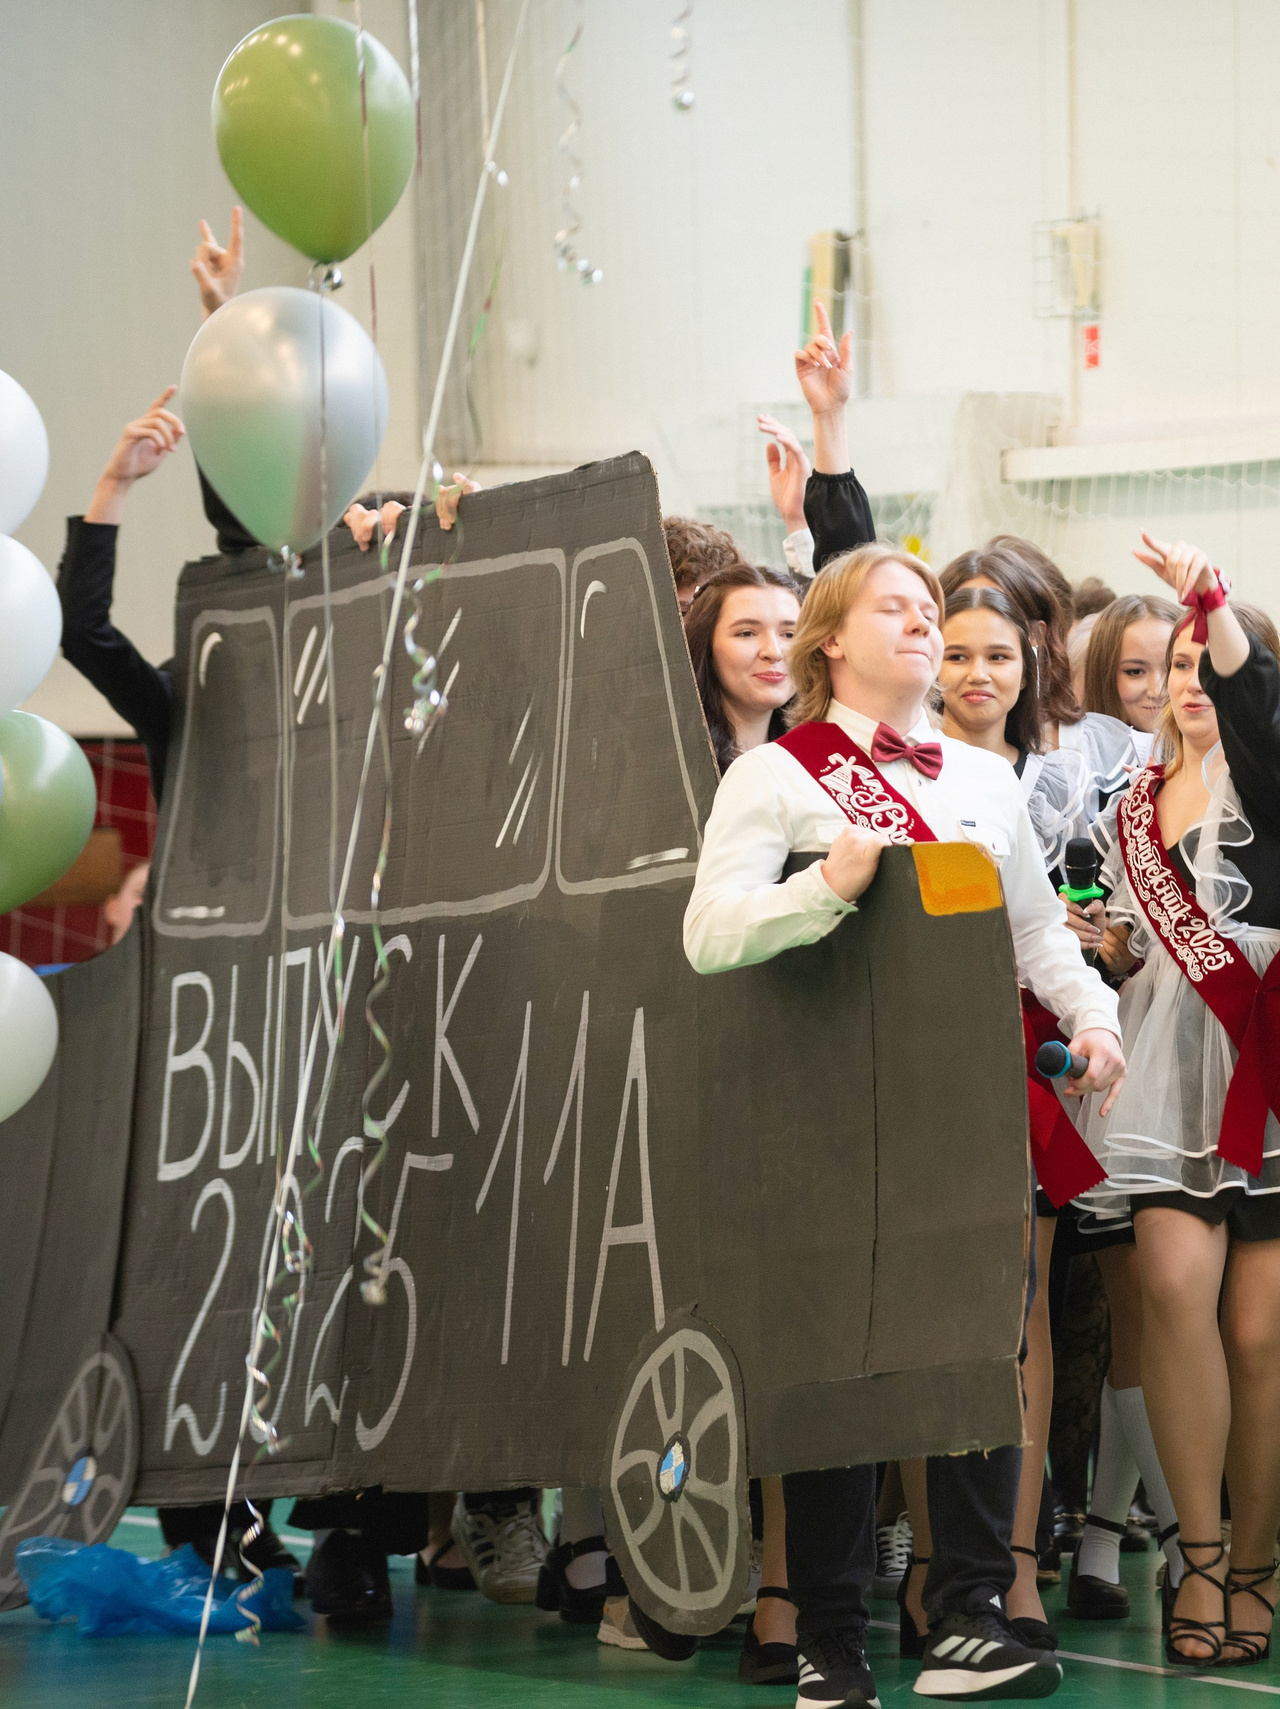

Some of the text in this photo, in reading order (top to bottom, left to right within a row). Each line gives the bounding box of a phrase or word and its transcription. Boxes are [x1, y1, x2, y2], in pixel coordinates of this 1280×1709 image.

[157, 934, 483, 1182] ВЫПУСК
[1179, 918, 1235, 971] 2025
[163, 1136, 455, 1456] 2025
